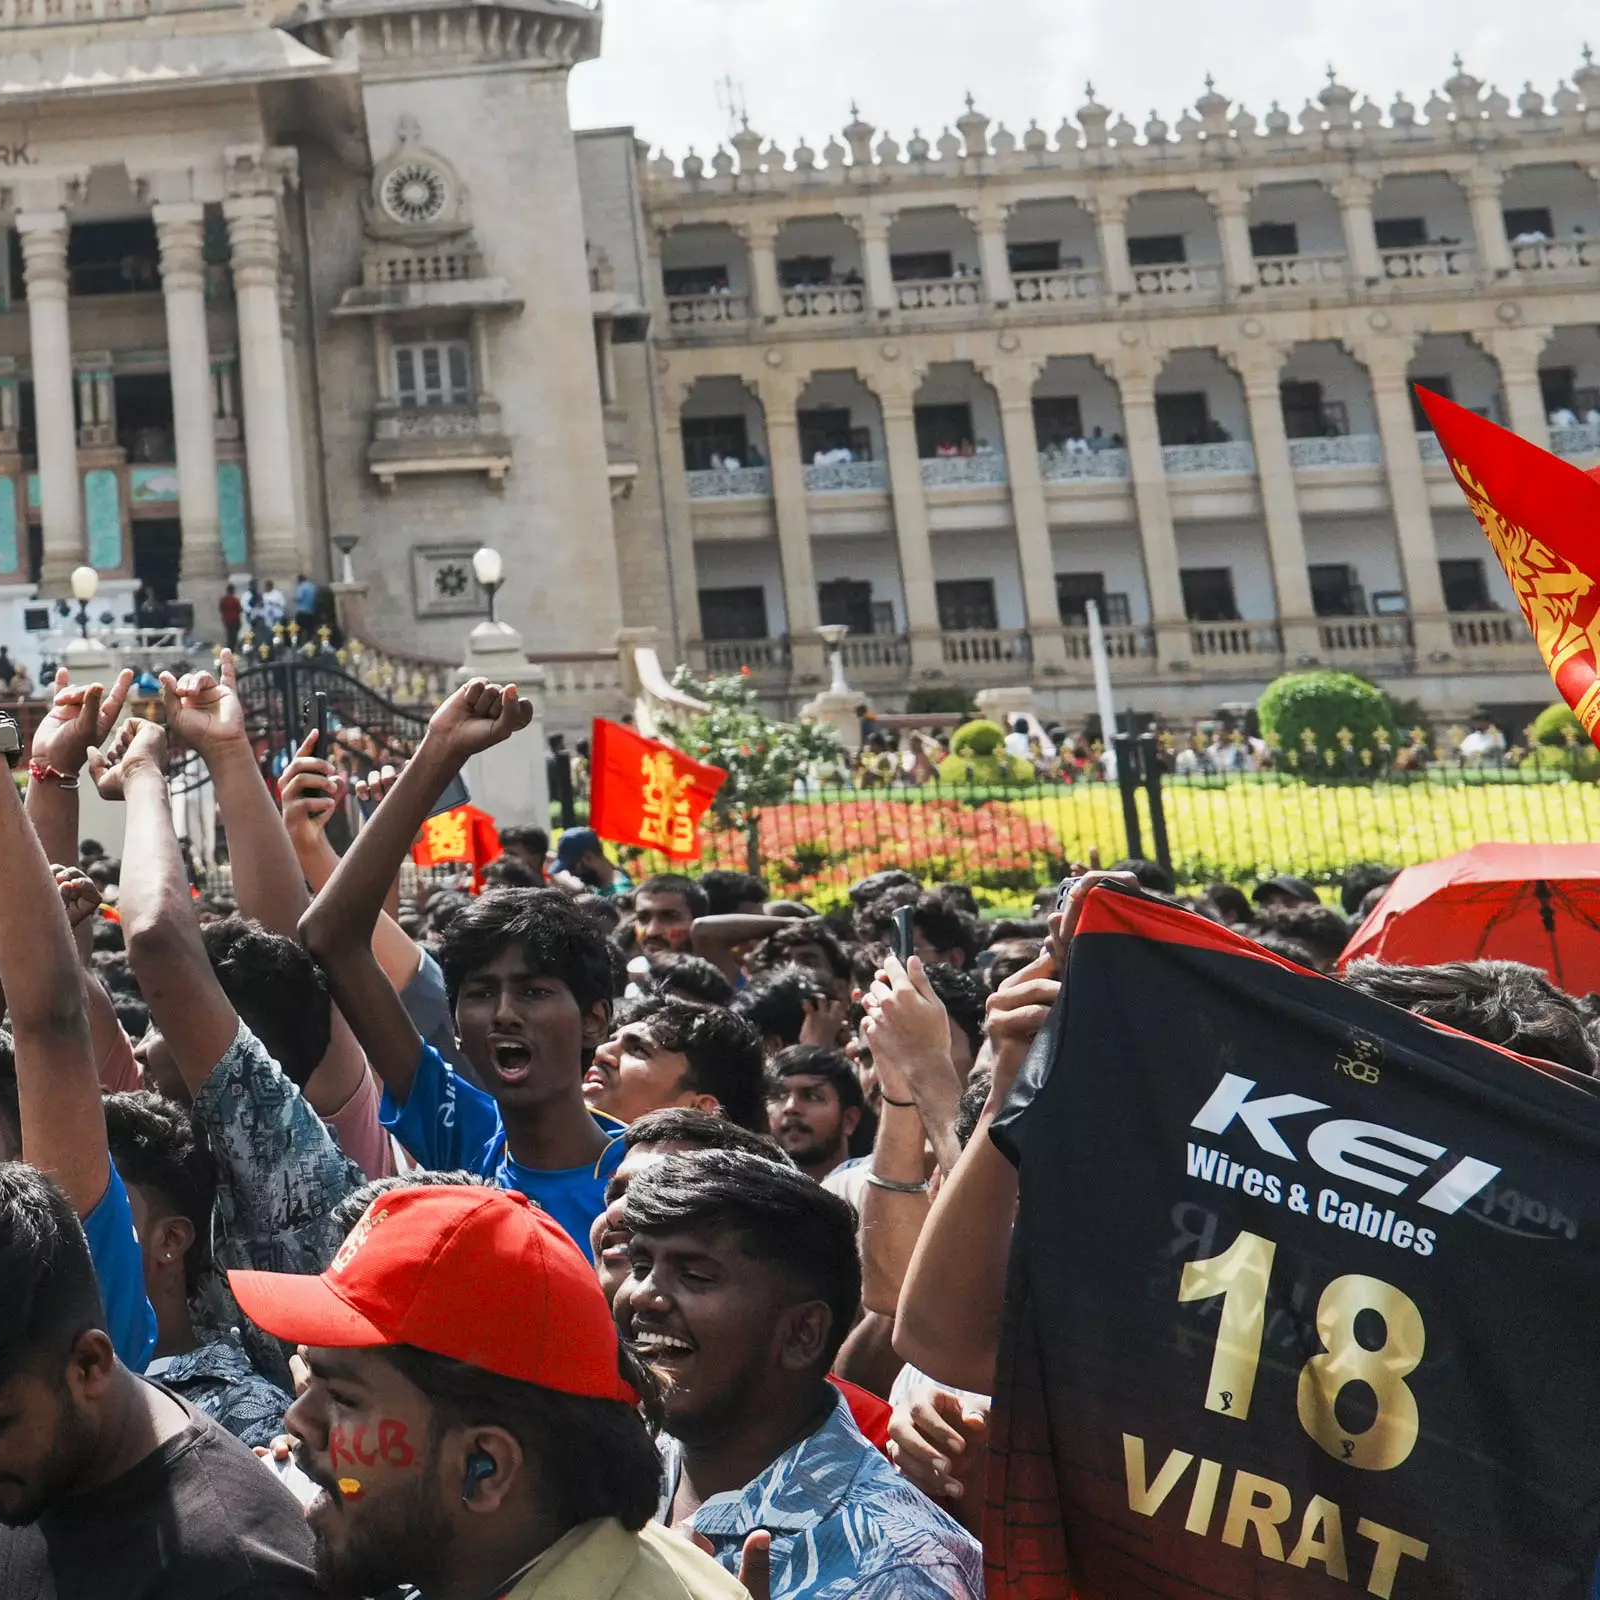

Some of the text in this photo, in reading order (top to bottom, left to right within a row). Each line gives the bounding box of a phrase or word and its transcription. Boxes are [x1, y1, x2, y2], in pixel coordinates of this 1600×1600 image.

[1333, 1053, 1381, 1084] RCB
[1186, 1141, 1282, 1205] Wires
[1287, 1182, 1310, 1216] &
[1316, 1188, 1438, 1257] Cables
[1190, 1071, 1503, 1216] KEI
[1177, 1229, 1426, 1472] 18
[329, 1418, 414, 1469] RCB
[1122, 1431, 1430, 1600] VIRAT
